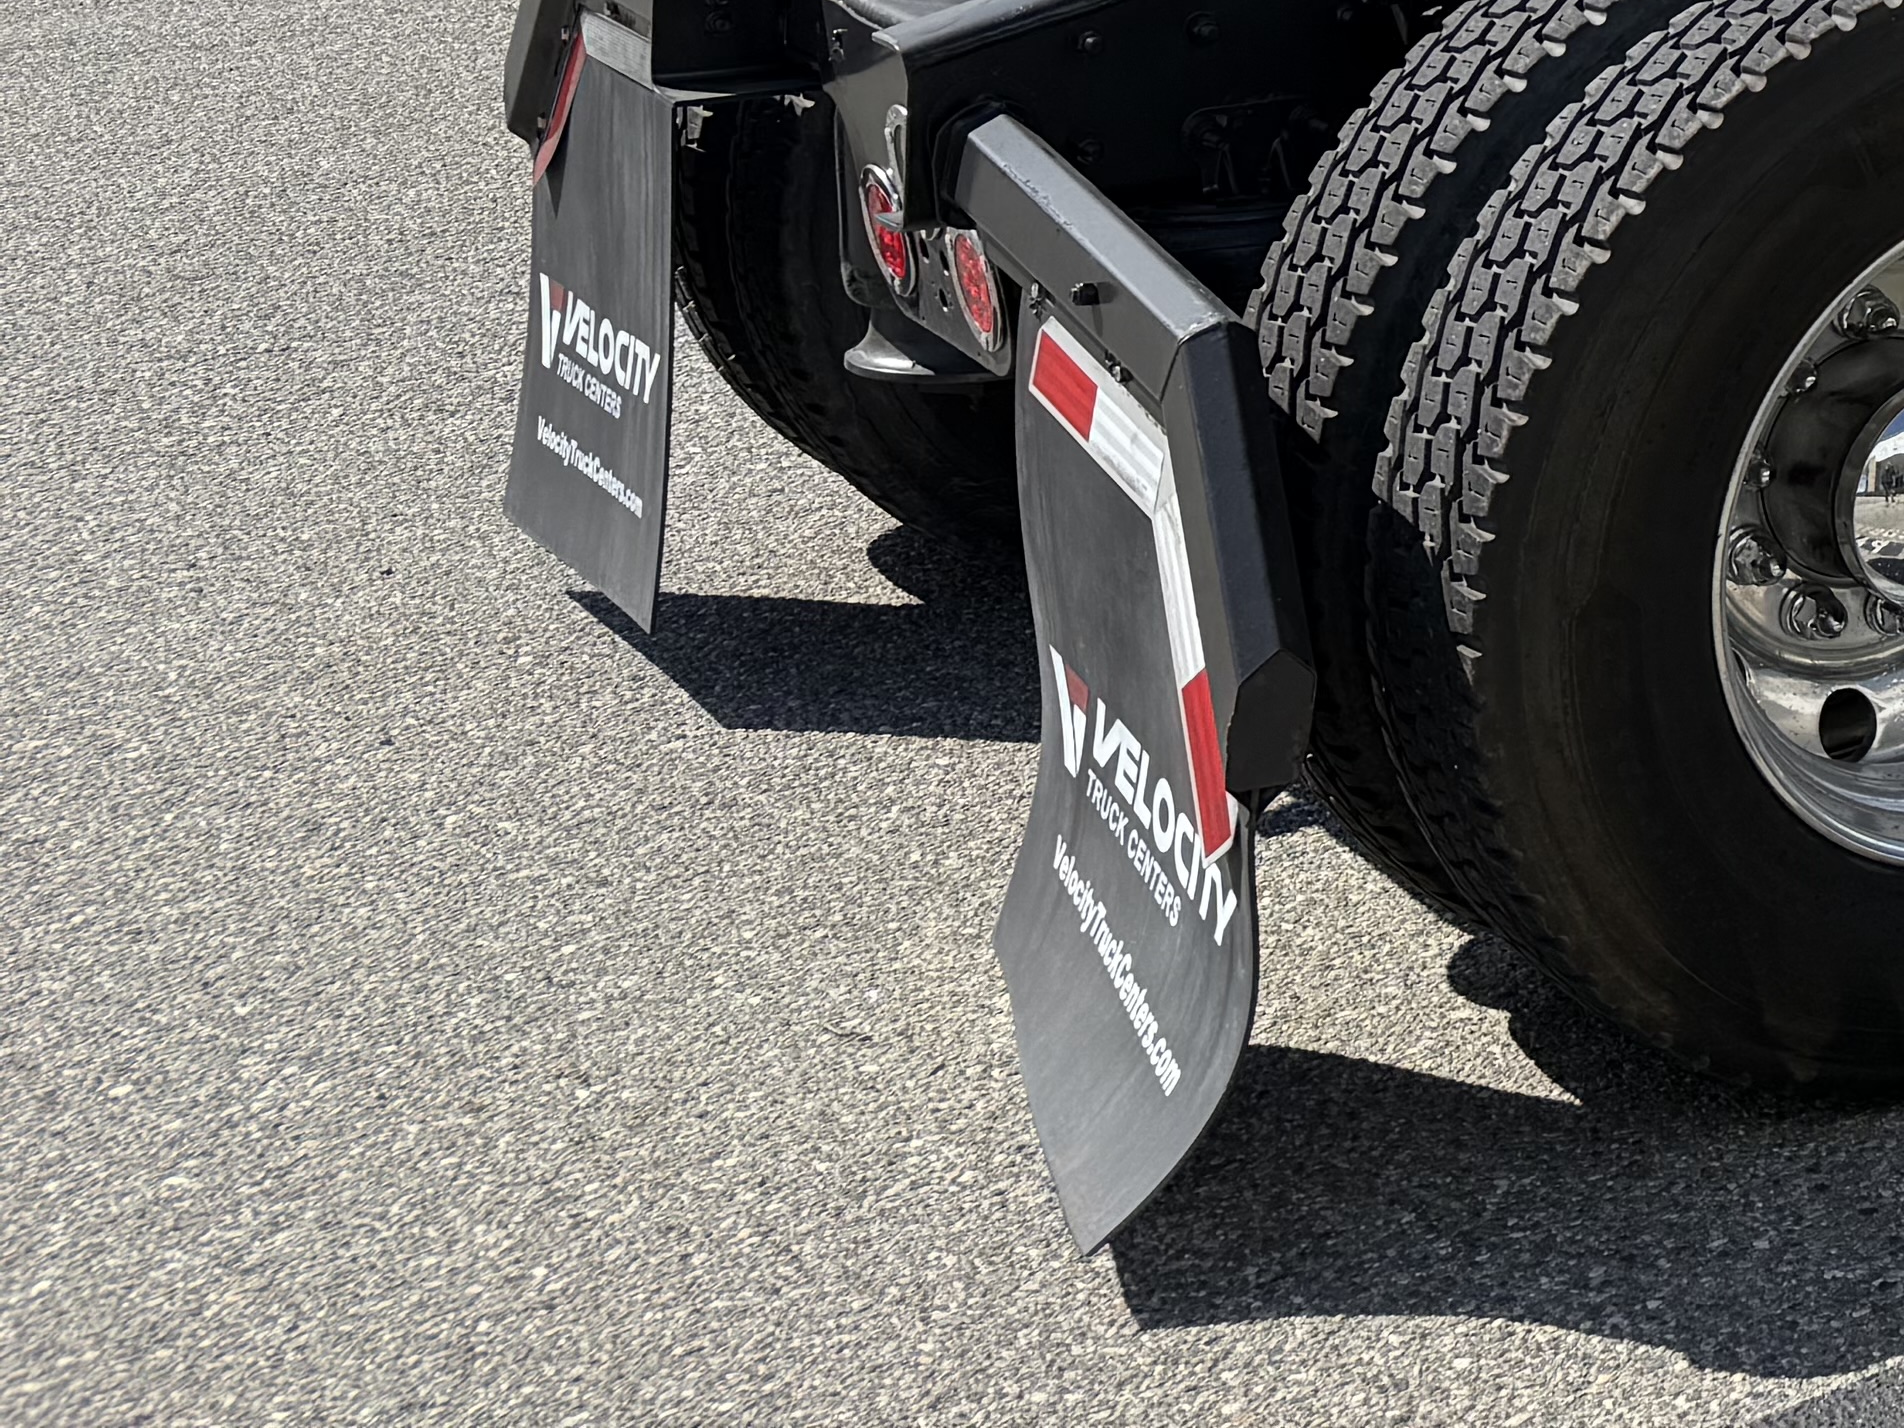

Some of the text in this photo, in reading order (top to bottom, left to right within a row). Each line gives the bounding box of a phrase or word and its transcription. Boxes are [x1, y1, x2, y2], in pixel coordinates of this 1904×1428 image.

[557, 353, 622, 419] TRUCK CENTERS
[563, 291, 661, 404] VELOCITY
[537, 416, 643, 519] VelocityTruckCenters.com
[1086, 768, 1181, 927] TRUCK CENTERS
[1053, 834, 1181, 1096] VelocityTruckCenters.com
